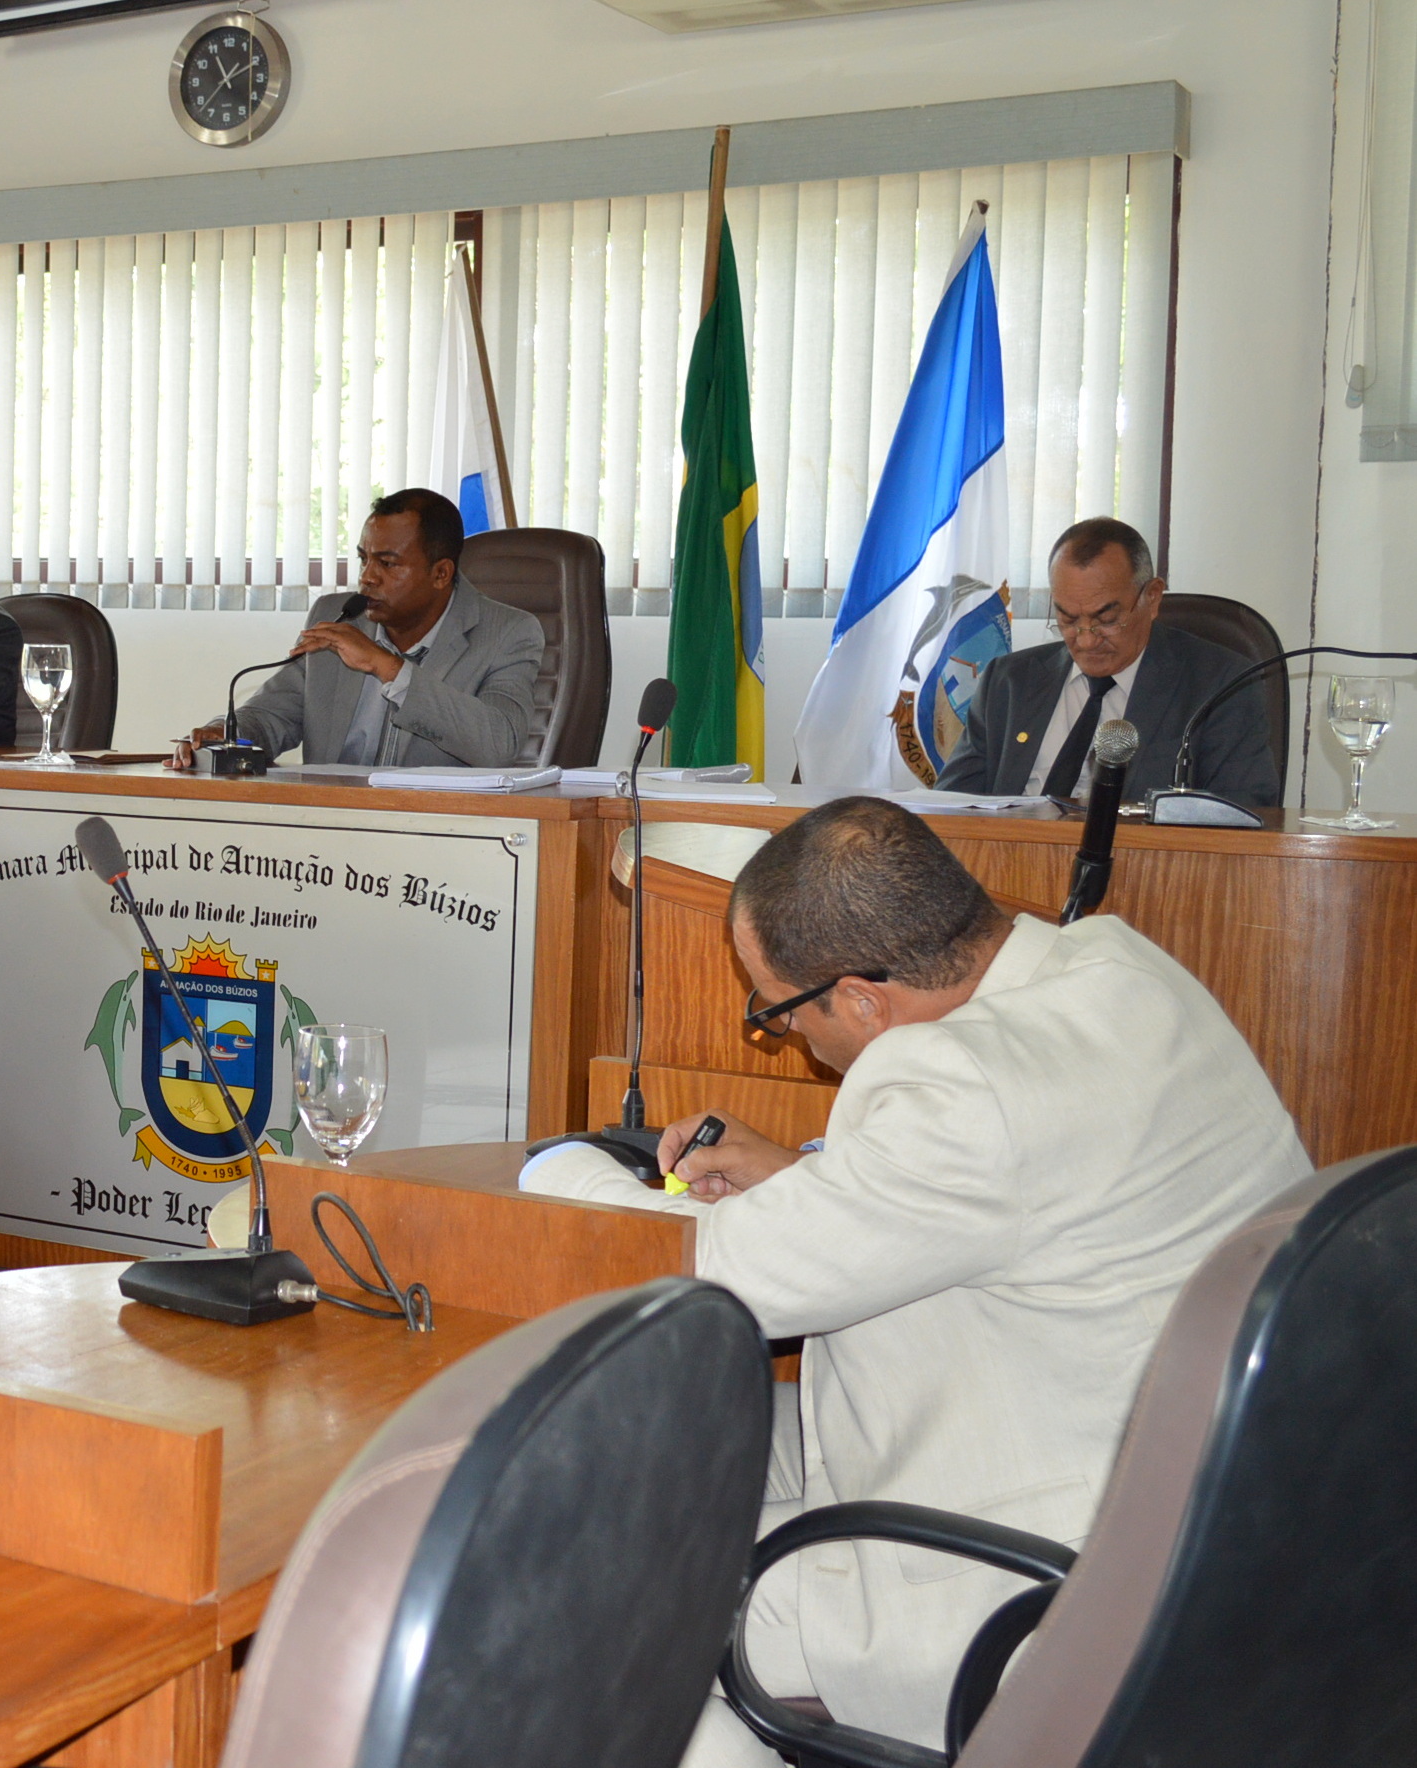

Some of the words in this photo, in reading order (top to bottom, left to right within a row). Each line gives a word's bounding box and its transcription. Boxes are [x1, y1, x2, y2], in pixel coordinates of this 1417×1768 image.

[223, 38, 235, 47] 12
[242, 42, 247, 52] 1
[208, 44, 218, 54] 11
[197, 59, 208, 70] 10
[252, 56, 260, 66] 2
[192, 77, 200, 87] 9
[256, 73, 264, 83] 3
[197, 96, 204, 105] 8
[251, 91, 258, 101] 4
[207, 108, 215, 118] 7
[238, 106, 246, 116] 5
[223, 112, 230, 122] 6
[56, 842, 179, 876] Mcipal
[188, 844, 215, 874] de
[220, 844, 334, 893] Armação
[345, 863, 392, 898] dos
[399, 873, 501, 932] Búzios
[170, 899, 189, 919] do
[195, 900, 223, 922] Rio
[225, 904, 245, 924] de
[250, 906, 317, 930] Janeiro
[160, 980, 204, 992] AMAÇÃO
[205, 984, 223, 994] DOS
[226, 985, 258, 998] BÚZIOS
[170, 1156, 198, 1176] 1740
[213, 1165, 242, 1179] 1995
[71, 1176, 153, 1218] Poder
